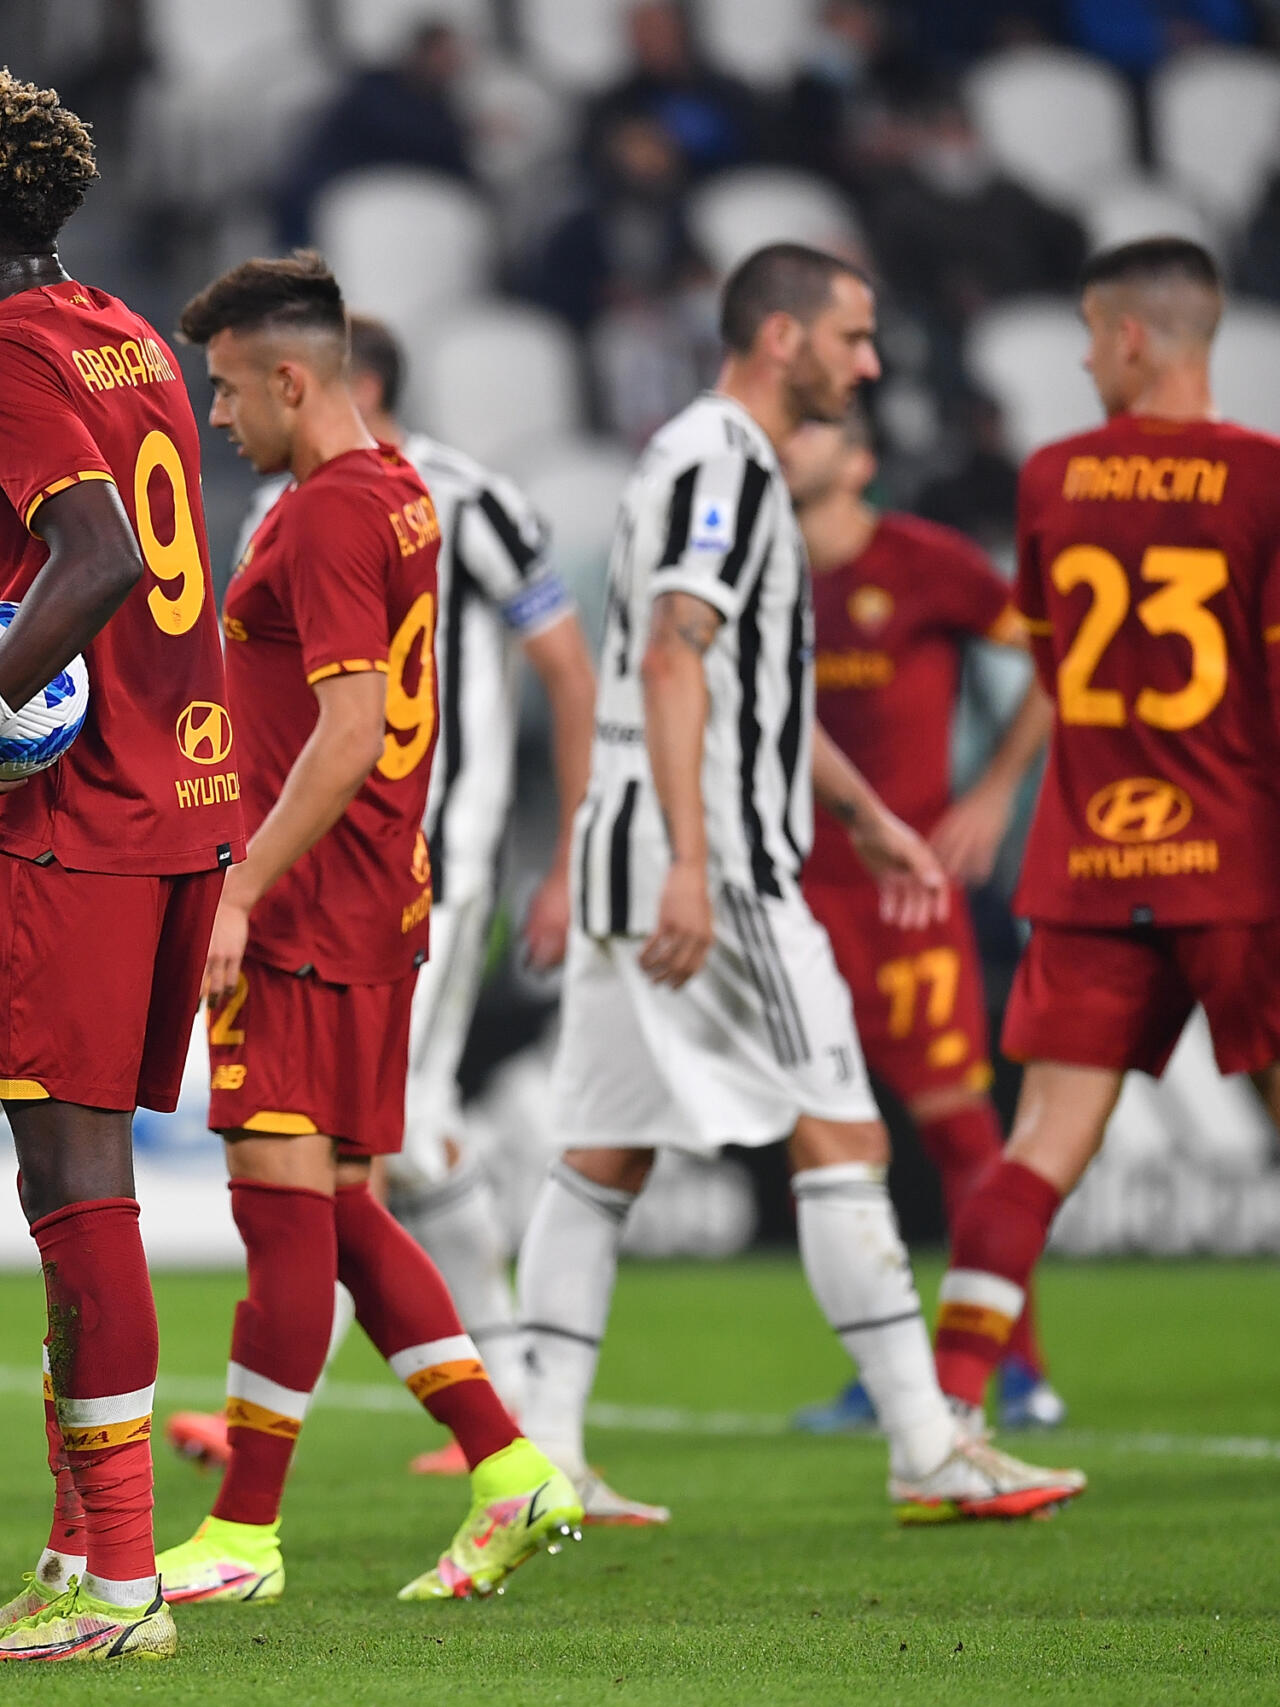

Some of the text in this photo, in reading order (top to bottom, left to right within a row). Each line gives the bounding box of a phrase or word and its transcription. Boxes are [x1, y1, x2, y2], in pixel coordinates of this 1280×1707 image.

[1063, 455, 1228, 505] MANCINI
[134, 430, 204, 636] 9
[1051, 543, 1229, 731] 23
[175, 771, 241, 809] HYUND
[1068, 839, 1219, 880] HYUNDAI
[205, 969, 249, 1045] 2
